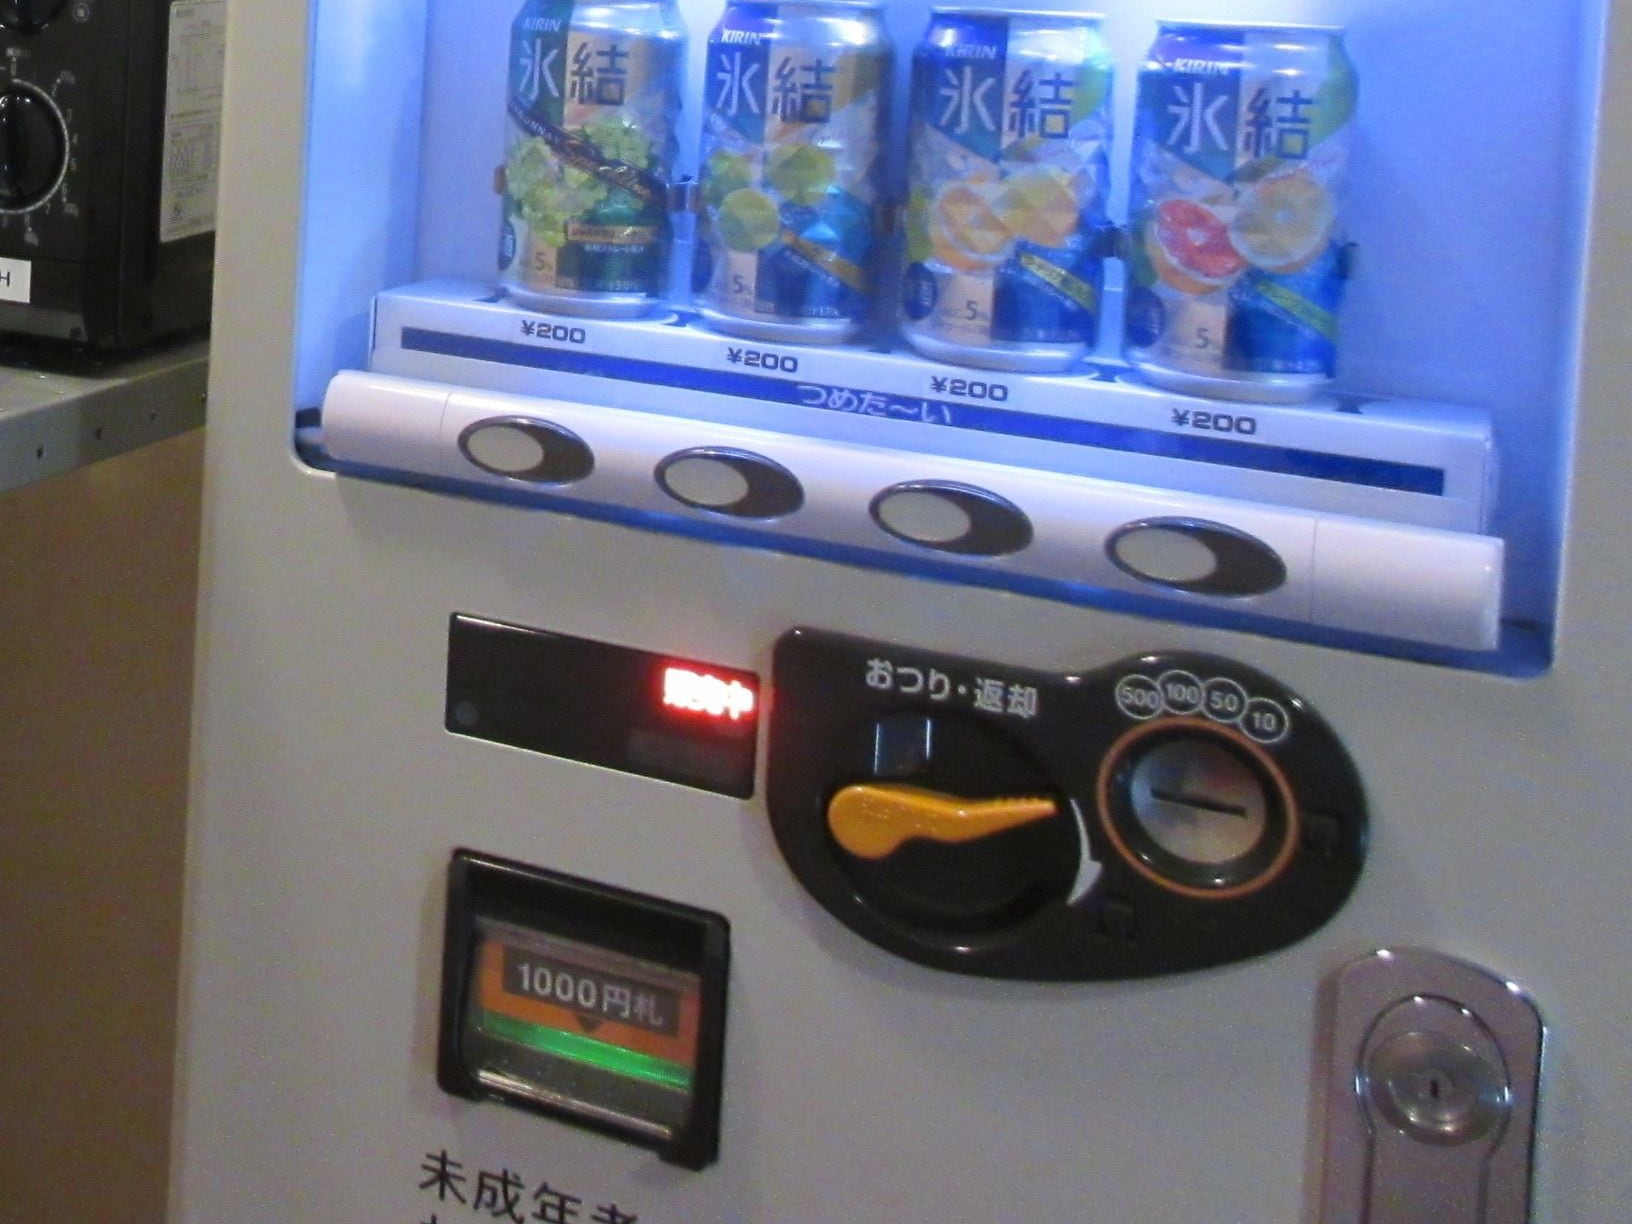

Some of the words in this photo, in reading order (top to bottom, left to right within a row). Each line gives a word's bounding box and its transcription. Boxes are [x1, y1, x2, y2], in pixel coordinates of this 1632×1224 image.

[720, 28, 766, 46] KIRIN
[518, 37, 630, 107] 氷結
[1172, 56, 1233, 75] KIRIN
[717, 51, 840, 124] 氷結
[938, 67, 1075, 141] 氷結
[1167, 80, 1315, 160] 氷結
[520, 318, 587, 345] ¥200
[726, 346, 800, 374] ¥200
[929, 375, 1009, 403] ¥200
[1169, 406, 1258, 436] ¥200
[865, 657, 1040, 720] おつり・返却
[1118, 685, 1159, 710] 500
[1166, 680, 1199, 705] 100
[1209, 688, 1240, 712] 50
[1251, 710, 1277, 732] 10
[516, 961, 665, 1028] 1000円札
